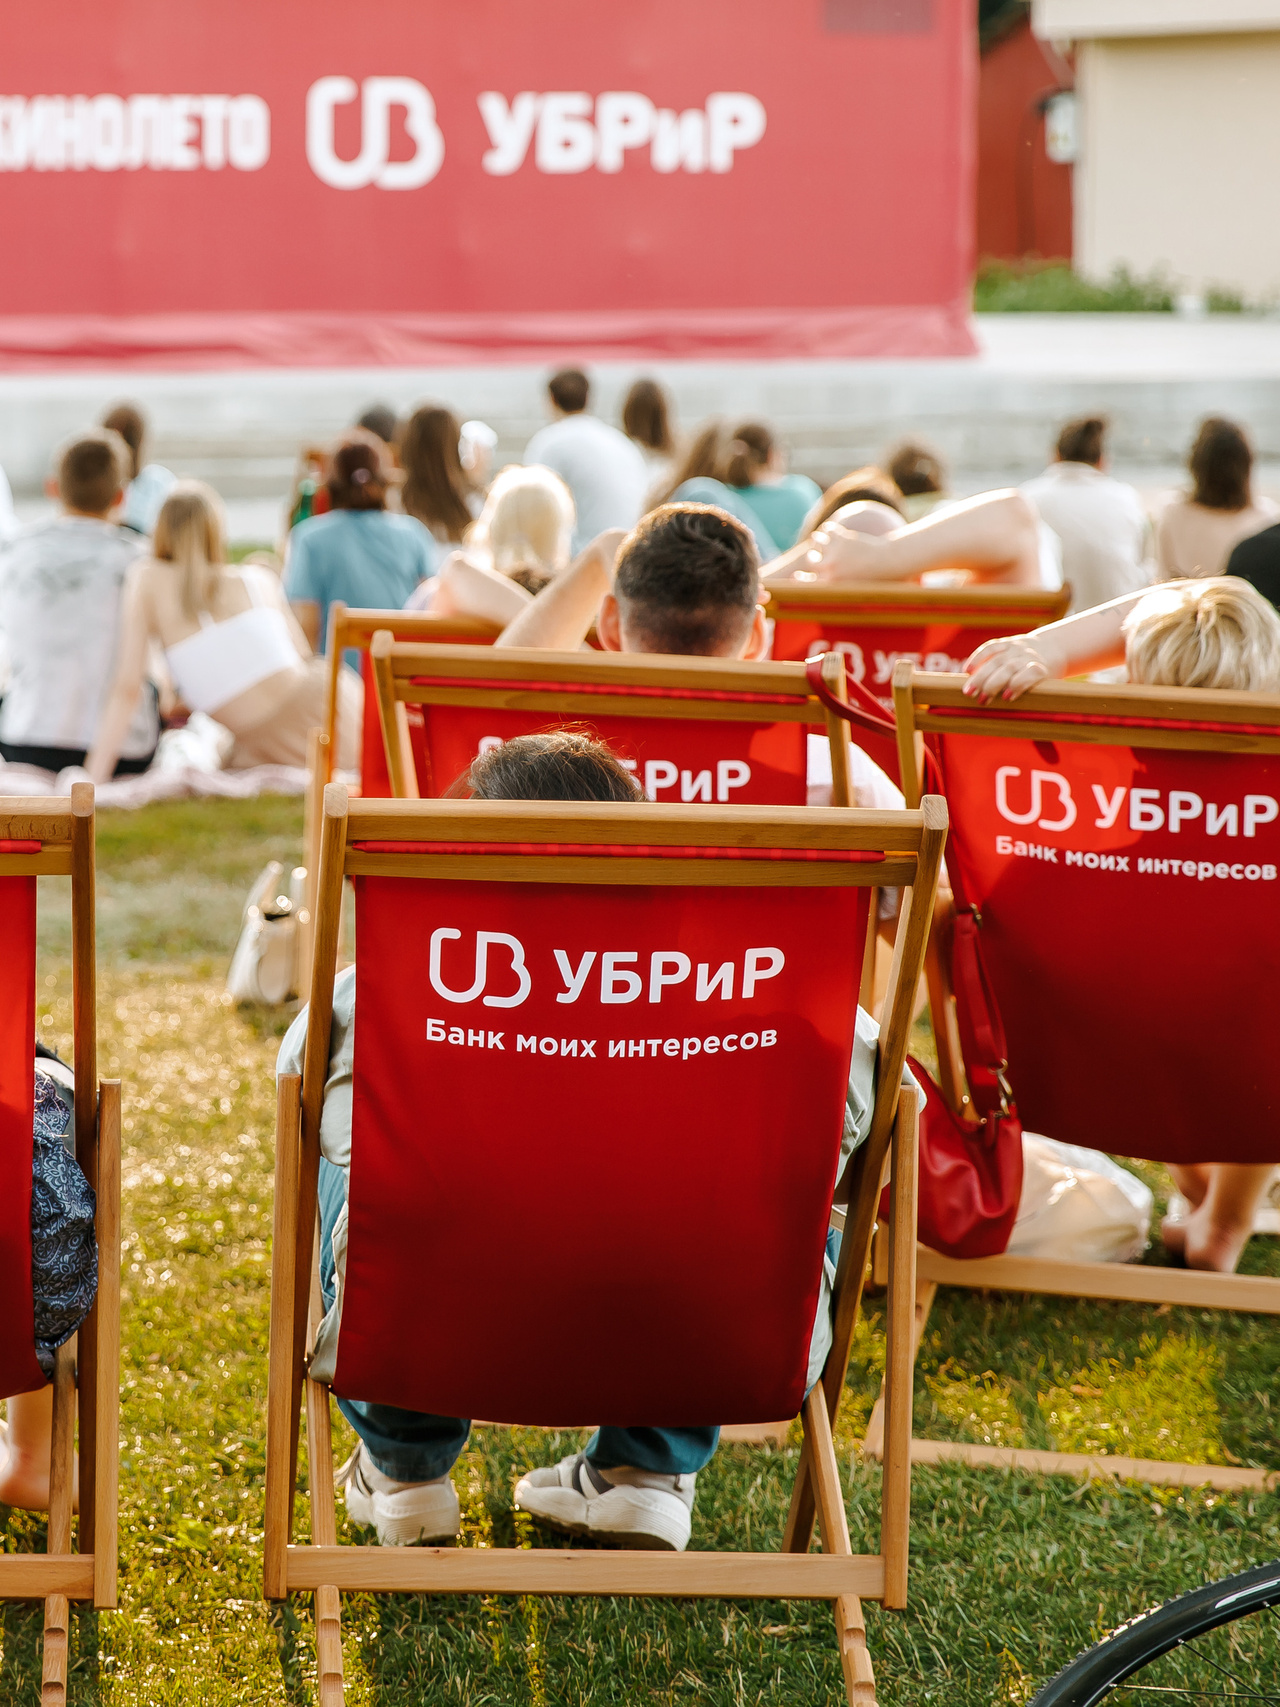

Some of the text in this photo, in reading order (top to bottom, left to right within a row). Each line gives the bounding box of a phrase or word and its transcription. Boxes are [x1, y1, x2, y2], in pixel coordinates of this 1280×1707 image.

[479, 92, 766, 174] УБРиР
[616, 759, 752, 802] РиР
[1092, 784, 1279, 837] УБРиР
[996, 835, 1277, 881] Банк моих интересов
[553, 947, 785, 1003] УБРиР
[427, 1018, 777, 1060] Банк моих интересов
